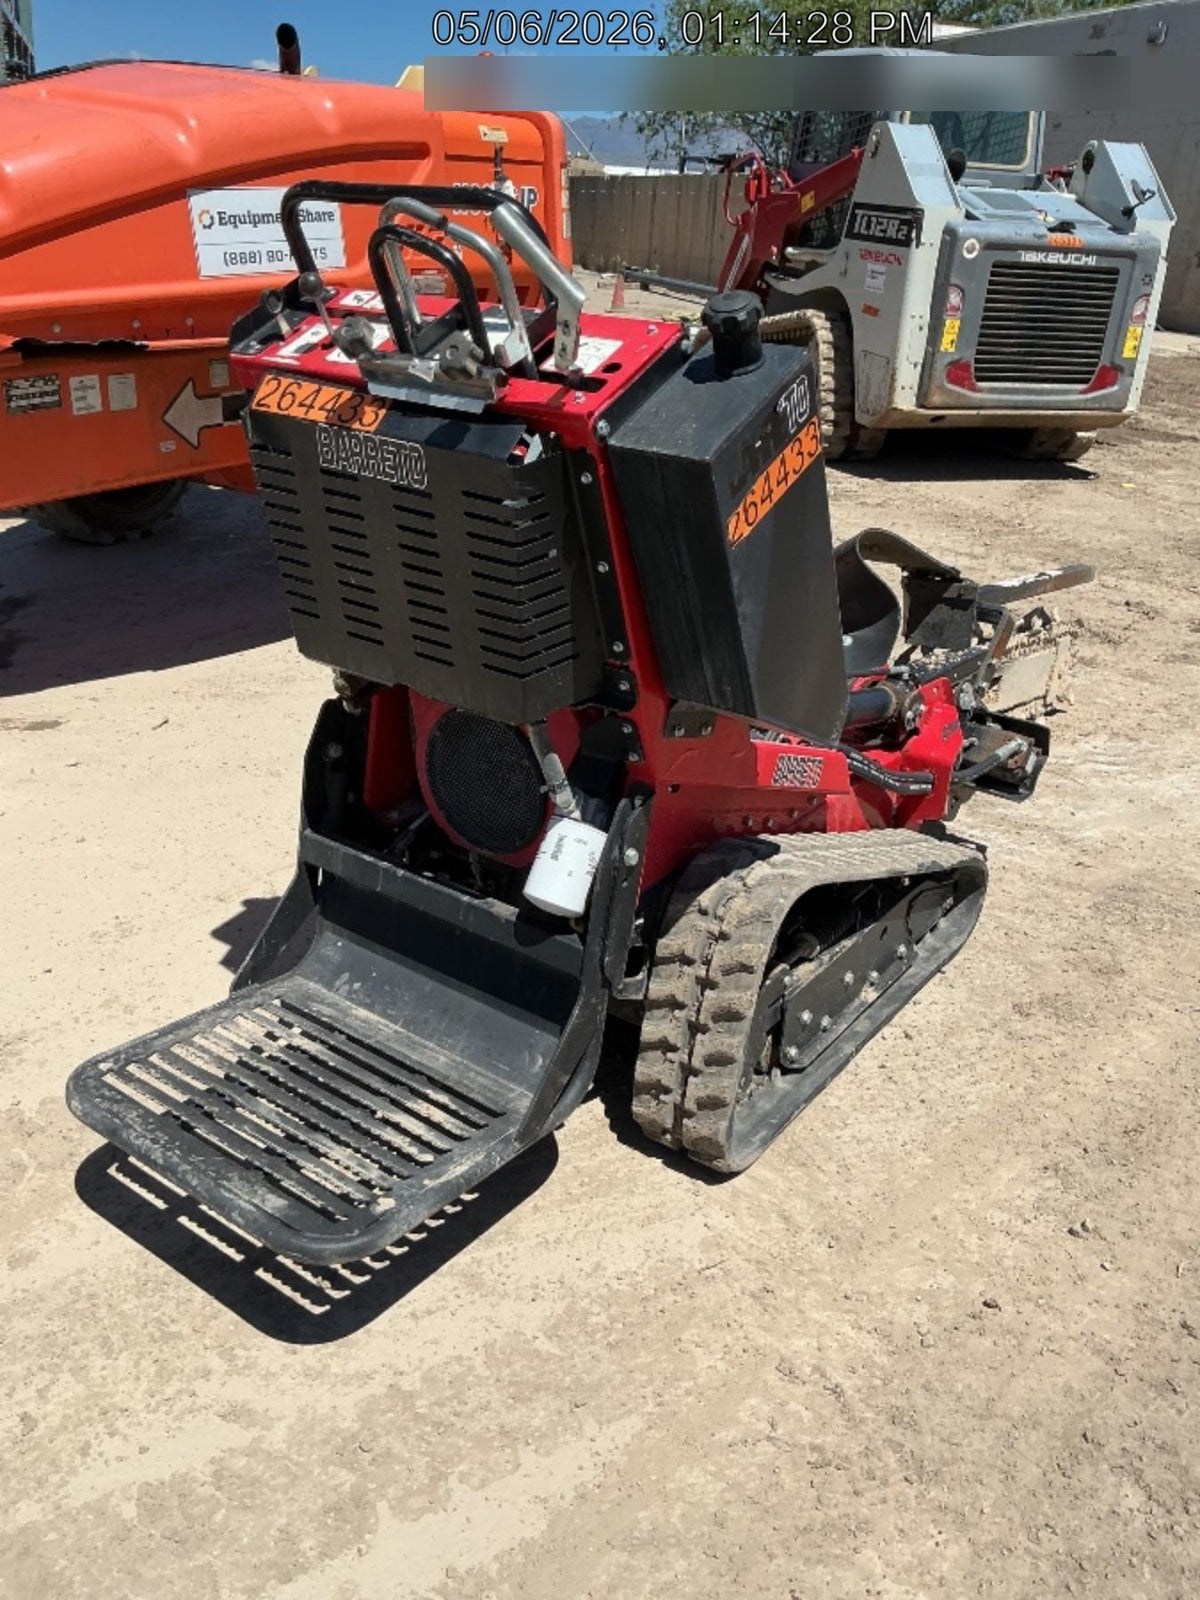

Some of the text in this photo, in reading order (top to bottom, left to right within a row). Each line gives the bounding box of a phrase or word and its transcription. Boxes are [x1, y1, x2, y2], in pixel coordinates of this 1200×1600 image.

[216, 208, 335, 229] EquipmeShare
[223, 247, 328, 267] (888) 80-TS
[1017, 250, 1097, 266] TAKEUCHI
[255, 377, 387, 427] 264433
[316, 422, 428, 489] BARRETO
[731, 420, 819, 547] 264433
